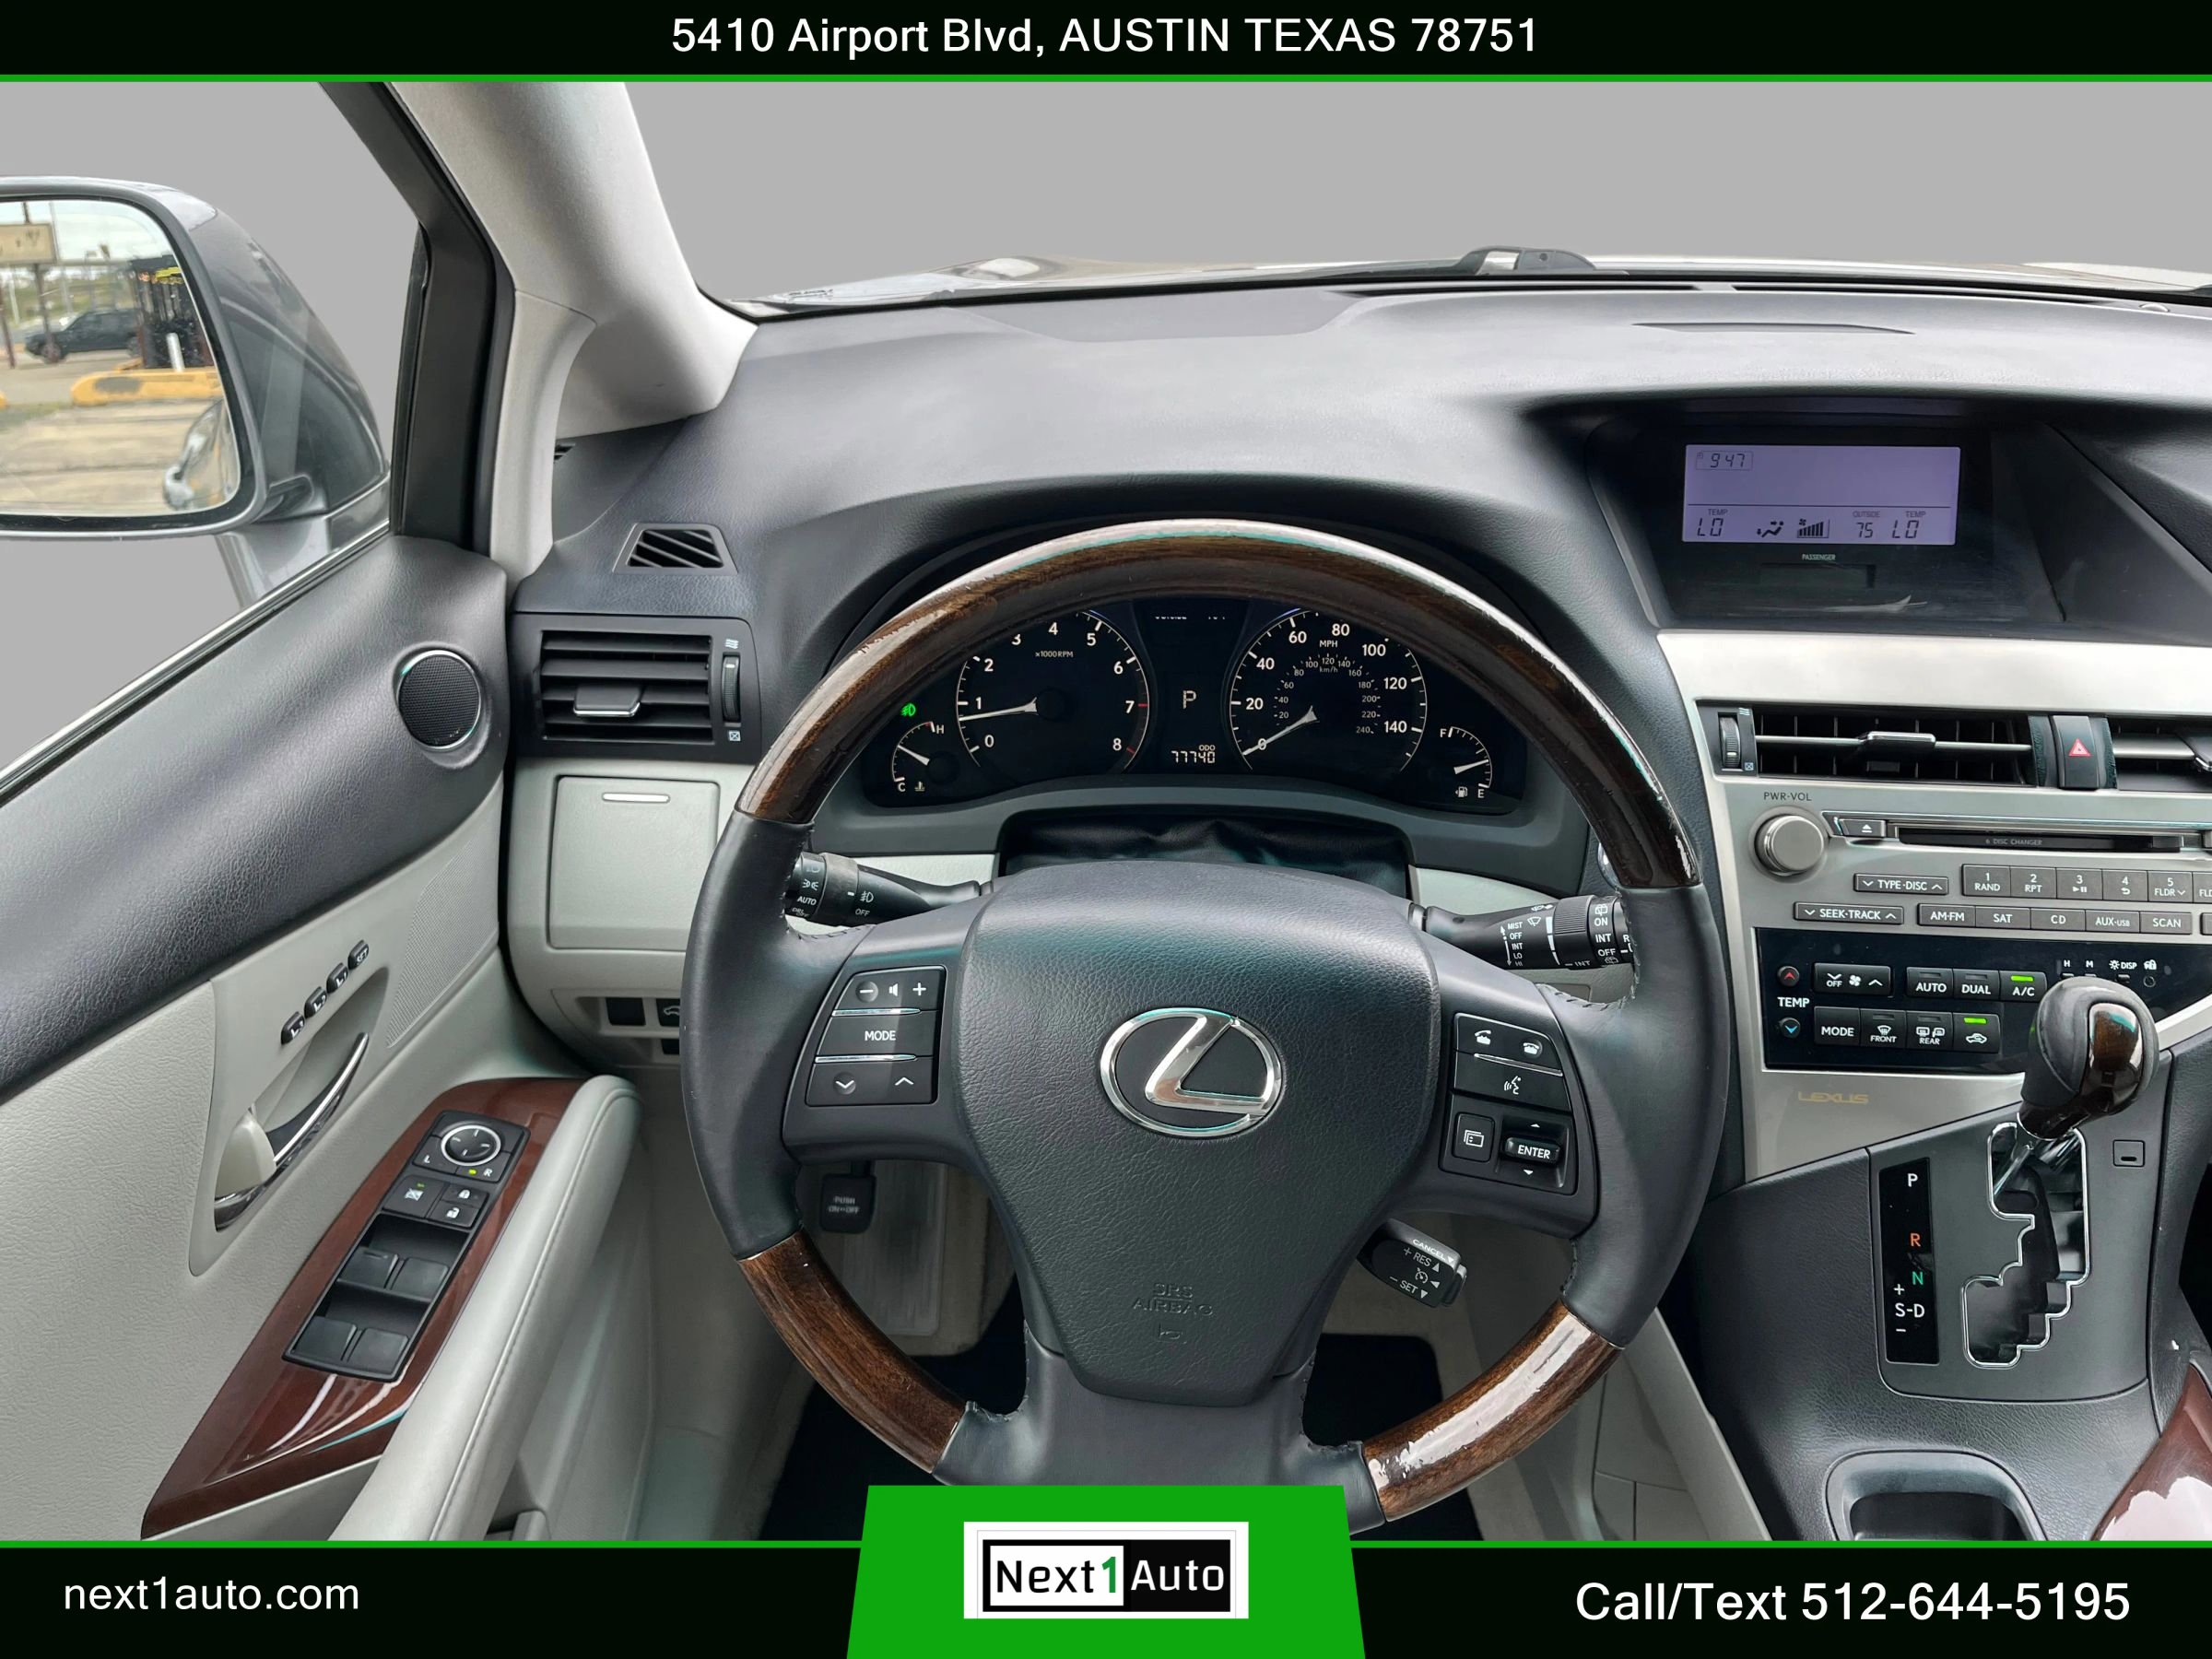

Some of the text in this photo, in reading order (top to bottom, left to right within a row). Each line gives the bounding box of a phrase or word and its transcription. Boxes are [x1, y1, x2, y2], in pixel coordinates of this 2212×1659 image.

[1856, 522, 1874, 538] 75
[1048, 622, 1059, 636] 4
[1332, 623, 1350, 636] 80
[1087, 632, 1097, 646] 5
[1288, 631, 1307, 644] 60
[1319, 640, 1338, 648] MPH
[1362, 644, 1386, 656] 100
[984, 659, 994, 673] 2
[1113, 661, 1124, 675] 6
[1256, 657, 1275, 670] 40
[1383, 677, 1406, 689] 120
[976, 698, 982, 709] 1
[1182, 690, 1197, 710] P
[1361, 695, 1377, 703] 200
[1125, 700, 1135, 714] 7
[1246, 698, 1264, 711] 20
[935, 725, 945, 735] H
[1384, 720, 1407, 734] 140
[1440, 728, 1446, 737] F
[984, 735, 994, 747] 0
[1112, 738, 1122, 752] 8
[1171, 750, 1216, 764] 77740
[898, 783, 906, 793] C
[1477, 788, 1485, 798] E
[1985, 873, 1990, 881] 1
[2030, 874, 2037, 883] 2
[2077, 875, 2083, 884] 3
[2122, 877, 2129, 886] 4
[2168, 877, 2174, 887] 5
[1974, 882, 2001, 891] RAND
[2024, 885, 2042, 893] RPT
[2154, 888, 2176, 897] FLDR
[796, 896, 817, 906] AUTO
[854, 908, 871, 917] OFF
[1594, 917, 1608, 926] ON
[1993, 913, 2013, 923] SAT
[2051, 915, 2066, 924] CD
[2152, 918, 2182, 928] SCAN
[1507, 922, 1523, 930] MIST
[1510, 932, 1523, 940] OFF
[1594, 933, 1612, 943] INT
[1512, 942, 1524, 950] INT
[1597, 948, 1616, 957] OFF
[2121, 961, 2137, 970] DISP
[1827, 980, 1842, 988] OFF
[1915, 982, 1947, 994] AUTO
[1961, 983, 1991, 995] DUAL
[2012, 986, 2035, 997] A/C
[1777, 996, 1810, 1008] TEMP
[865, 1030, 897, 1041] MODE
[1821, 1027, 1854, 1037] MODE
[1870, 1035, 1897, 1043] FRONT
[1919, 1037, 1940, 1045] REAR
[1798, 1091, 1868, 1104] LEXUS
[1517, 1145, 1550, 1159] ENTER
[424, 1155, 430, 1163] L
[484, 1168, 492, 1177] R
[1907, 1173, 1918, 1187] P
[1910, 1232, 1921, 1247] R
[1412, 1239, 1446, 1261] CANCEL
[1413, 1252, 1432, 1267] RES
[1912, 1272, 1924, 1286] N
[1153, 1283, 1194, 1298] SRS
[1399, 1280, 1418, 1294] SET
